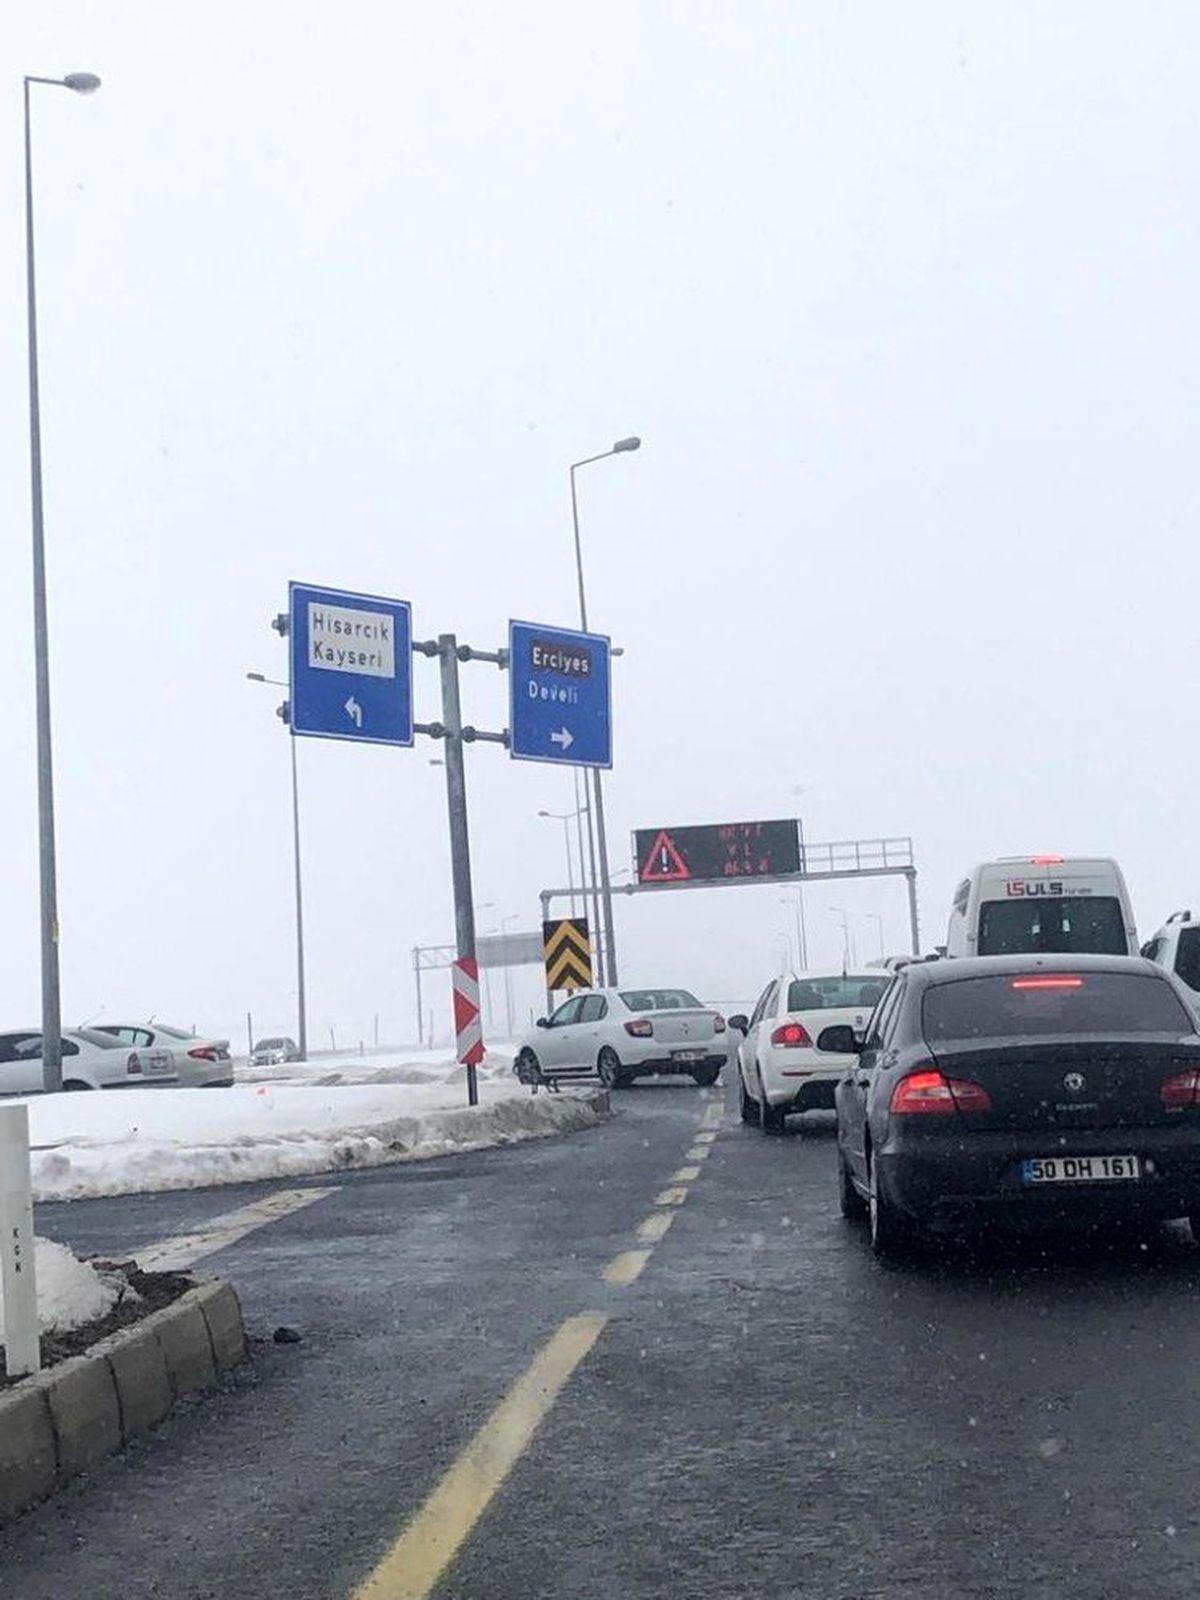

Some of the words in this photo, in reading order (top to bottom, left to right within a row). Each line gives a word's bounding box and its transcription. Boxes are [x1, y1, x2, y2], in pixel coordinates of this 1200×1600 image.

[313, 641, 382, 668] Kayseri
[532, 646, 589, 673] Erciyes
[528, 680, 579, 704] Develi
[1032, 1160, 1056, 1179] 50
[1063, 1159, 1092, 1178] DH
[1102, 1158, 1135, 1176] 161
